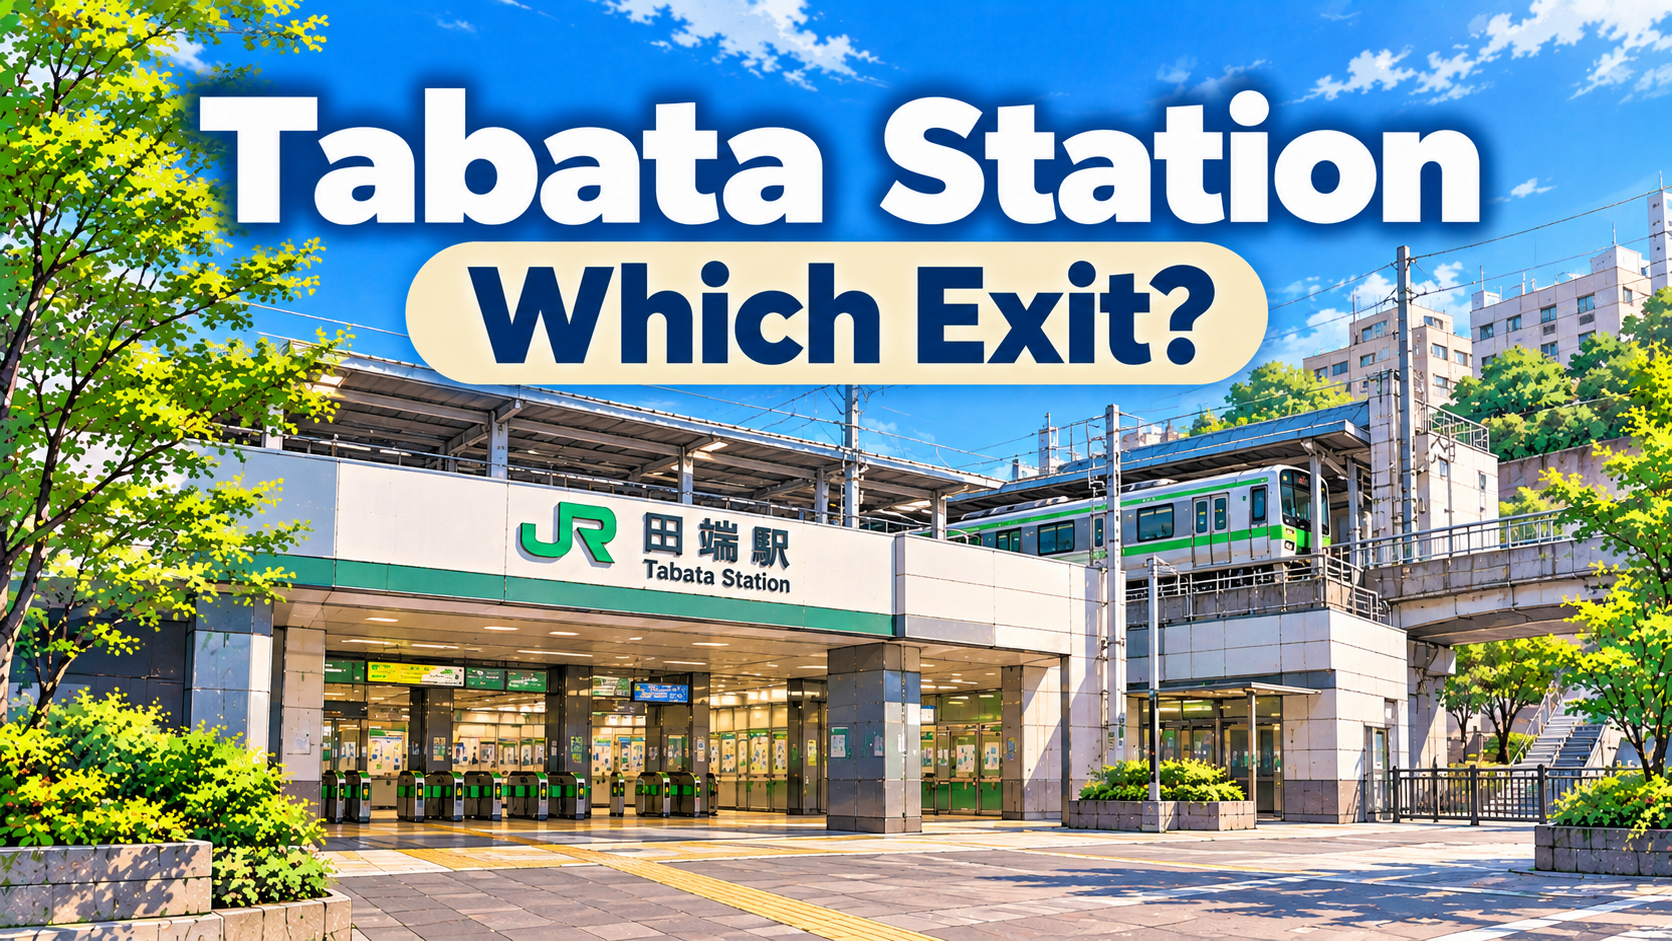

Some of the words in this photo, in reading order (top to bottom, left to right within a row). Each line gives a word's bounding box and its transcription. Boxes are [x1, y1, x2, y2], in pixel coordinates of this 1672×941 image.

[521, 501, 617, 564] JR
[645, 512, 790, 569] 田端駅
[644, 559, 715, 585] Tabata
[722, 569, 791, 593] Station
